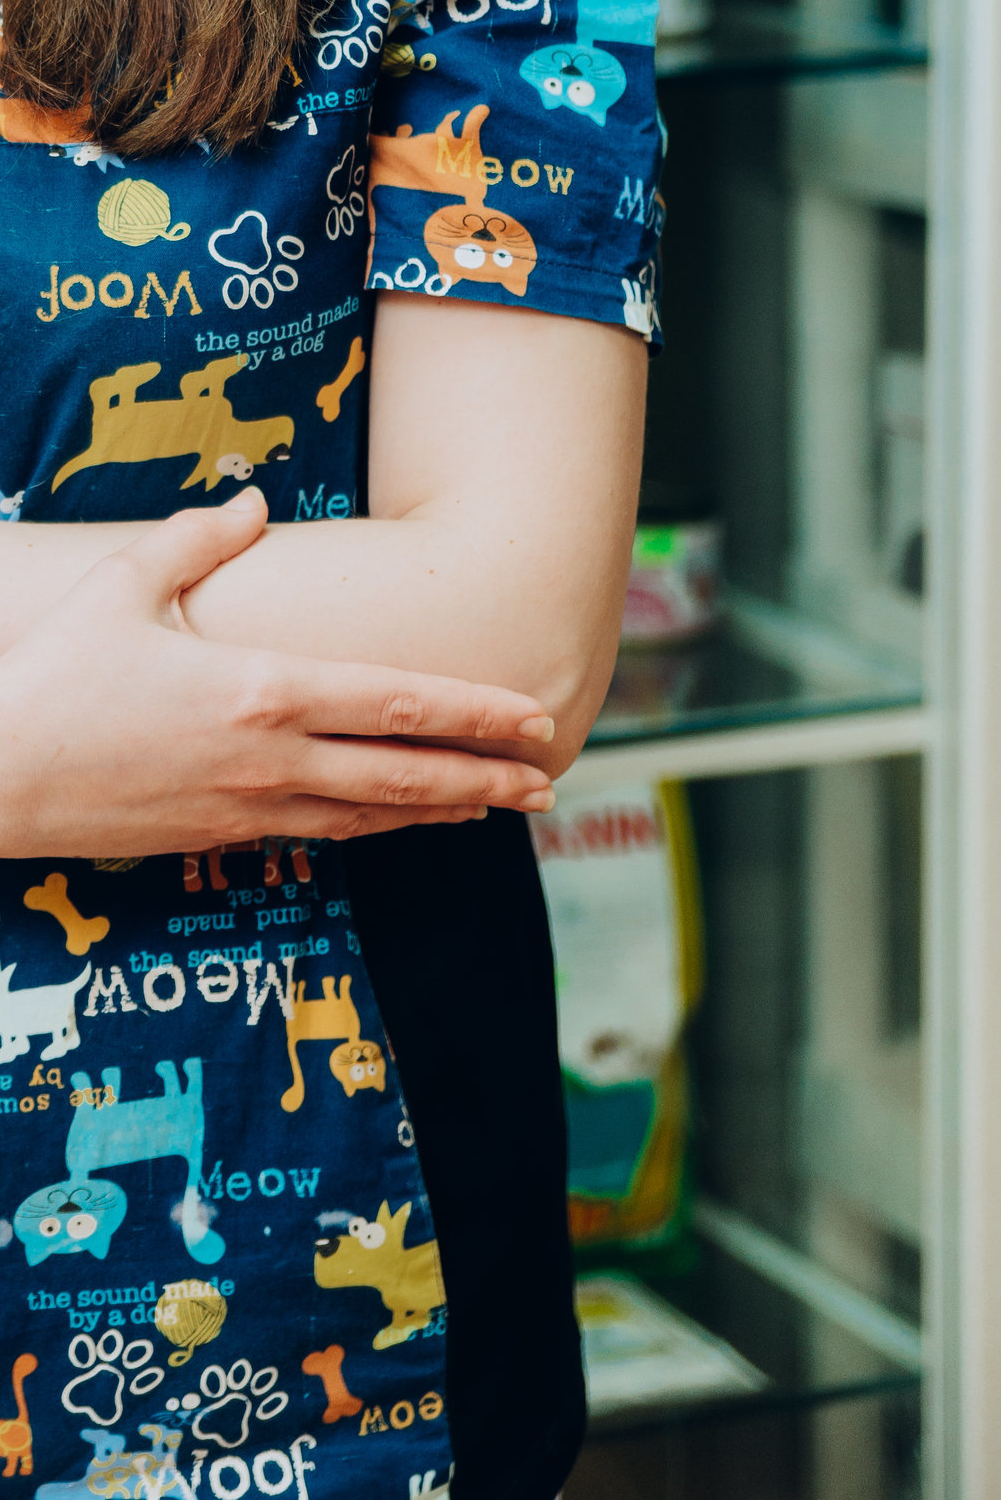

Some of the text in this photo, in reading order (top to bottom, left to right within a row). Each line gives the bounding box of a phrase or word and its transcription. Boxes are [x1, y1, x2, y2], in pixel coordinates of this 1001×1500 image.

[297, 78, 377, 114] the sou
[434, 135, 575, 196] Meow
[36, 265, 203, 322] Woof
[195, 296, 360, 352] the sound made
[236, 330, 326, 371] by a dog
[227, 887, 267, 909] cat
[168, 912, 236, 937] made
[129, 951, 174, 973] the
[187, 941, 264, 968] sound
[83, 956, 296, 1026] Meow
[28, 1063, 65, 1090] by
[69, 1084, 118, 1110] the
[196, 1160, 323, 1202] Meow
[27, 1276, 236, 1311] the sound made
[67, 1303, 179, 1333] by a dog
[358, 1391, 444, 1437] eow
